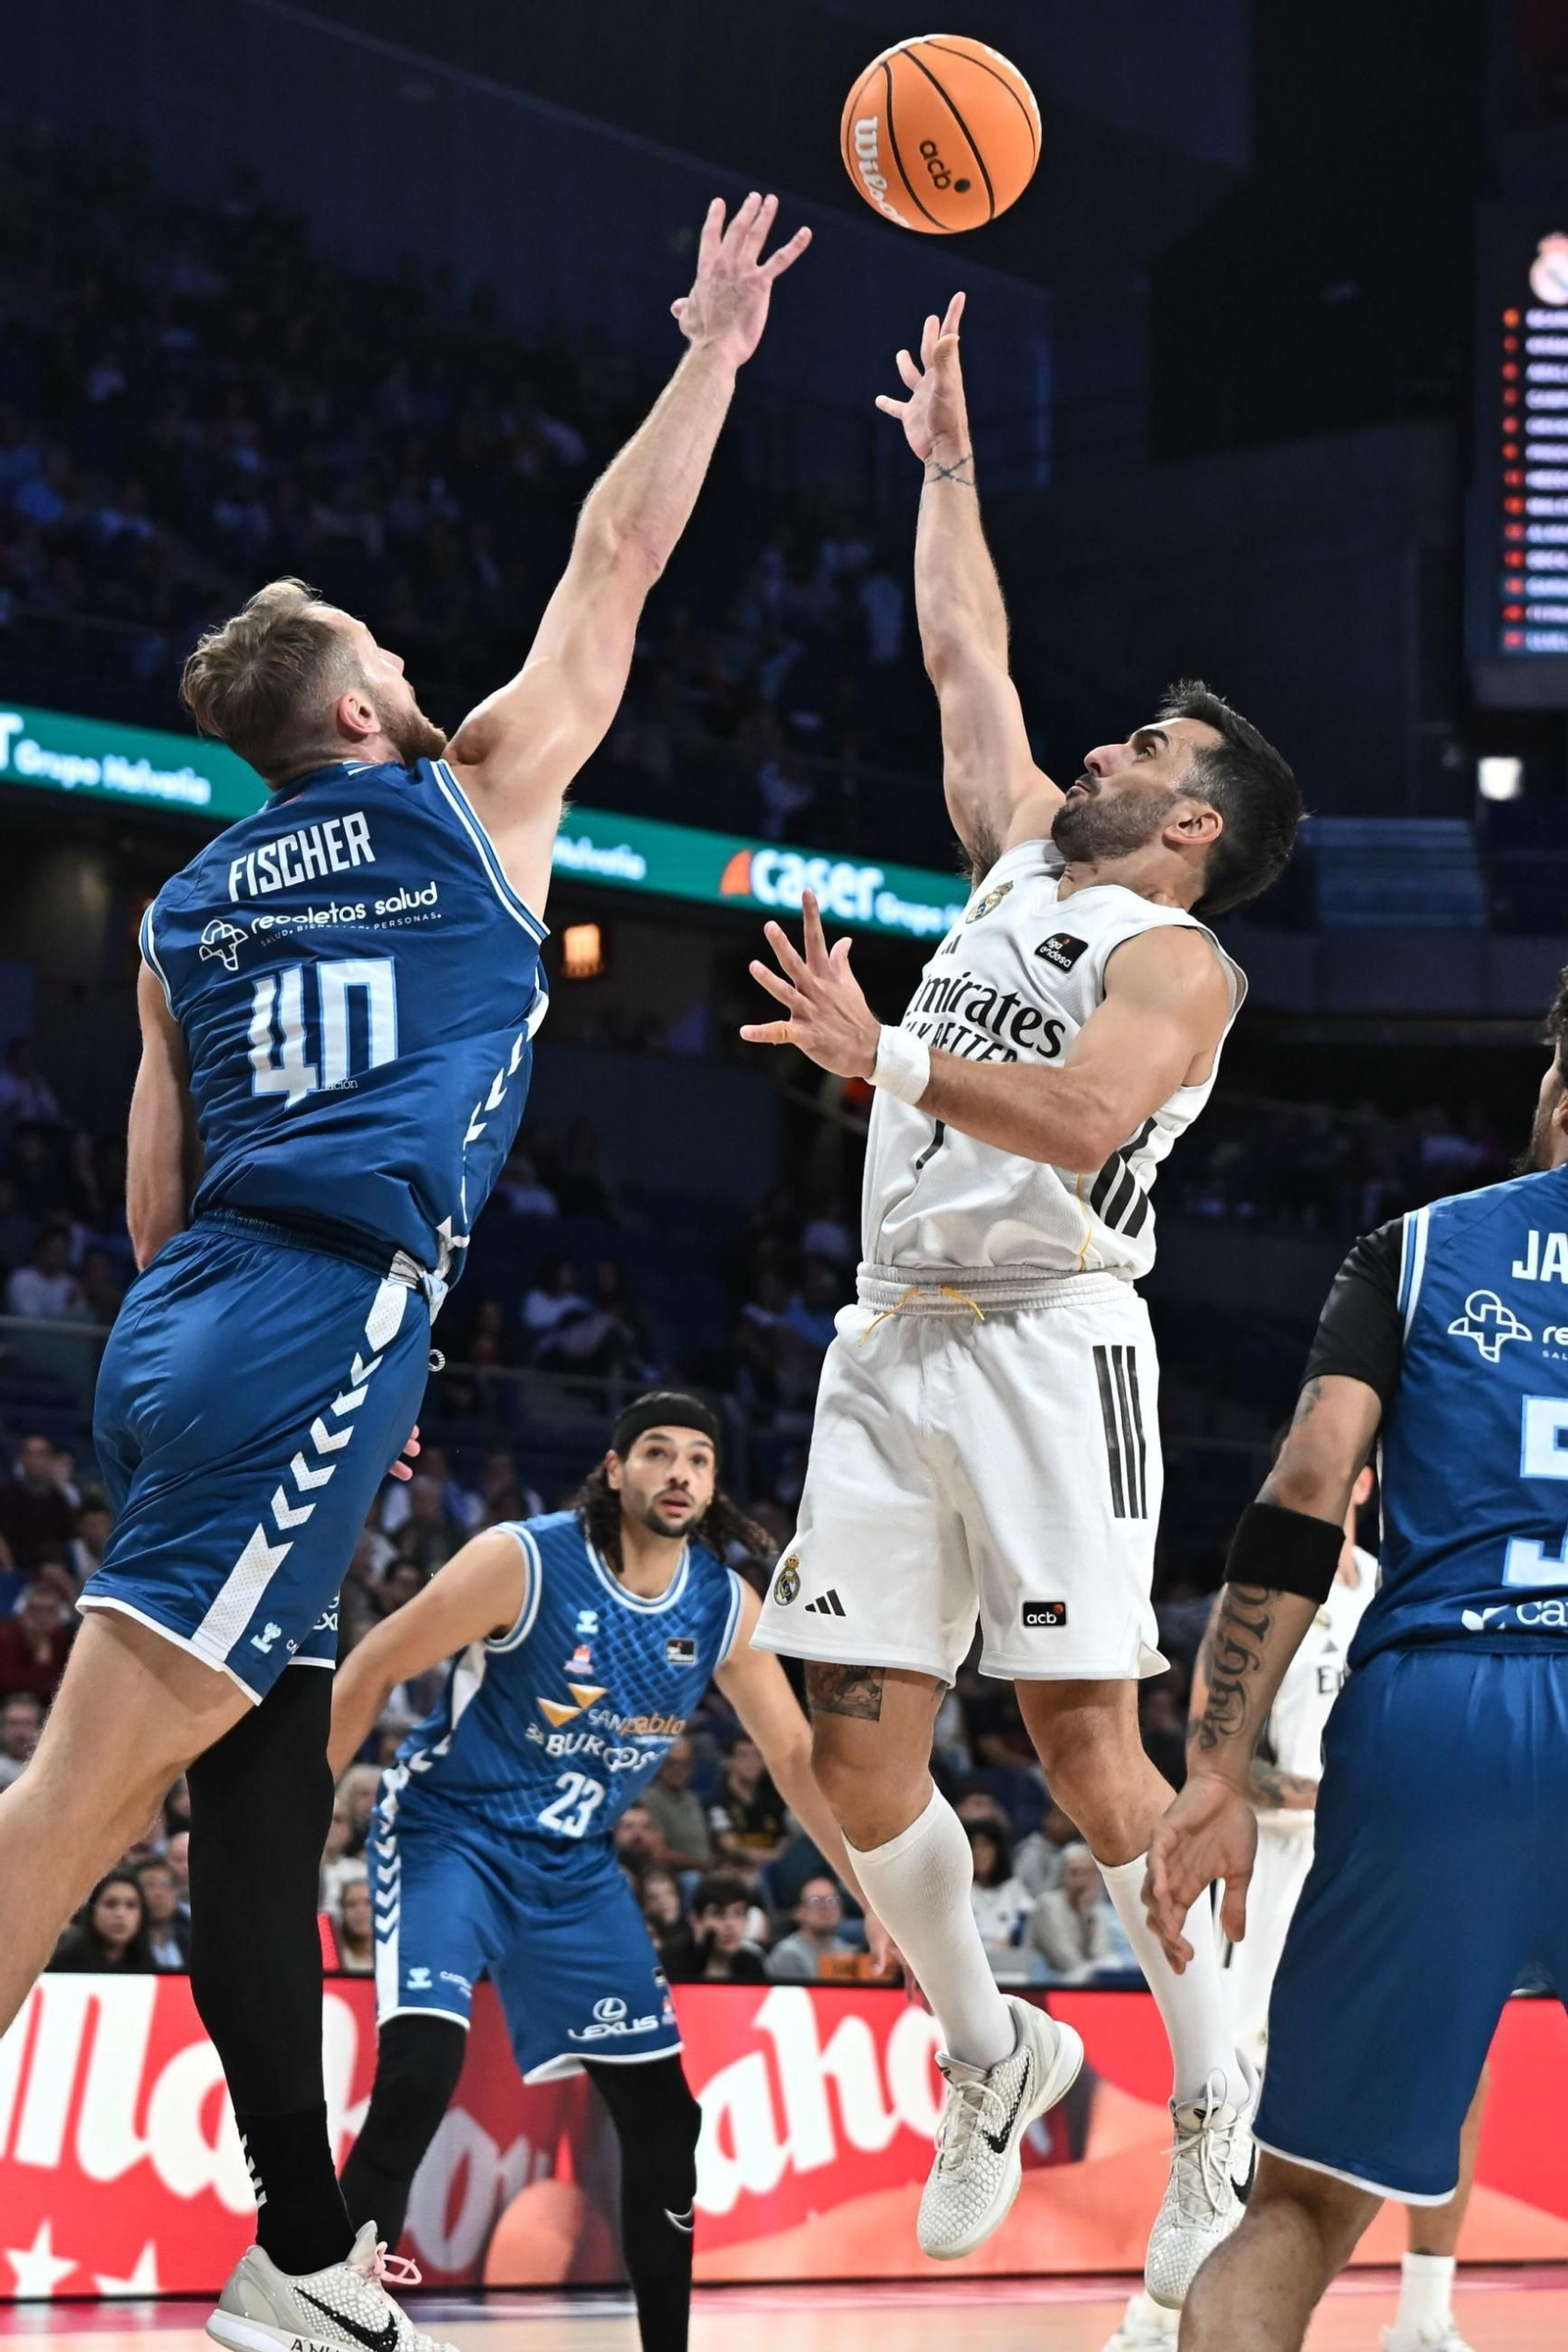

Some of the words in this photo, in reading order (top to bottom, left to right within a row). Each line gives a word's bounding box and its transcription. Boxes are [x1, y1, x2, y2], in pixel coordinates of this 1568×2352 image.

[919, 140, 952, 190] acb
[228, 810, 376, 903] FISCHER
[374, 881, 438, 915] salud
[373, 911, 442, 931] PERSONAS.
[1039, 946, 1072, 967] endesa
[247, 956, 398, 1111] 40
[906, 970, 1066, 1058] mirates
[1026, 1611, 1057, 1625] acb
[537, 1771, 605, 1838] 23
[567, 2015, 660, 2042] LEXUS
